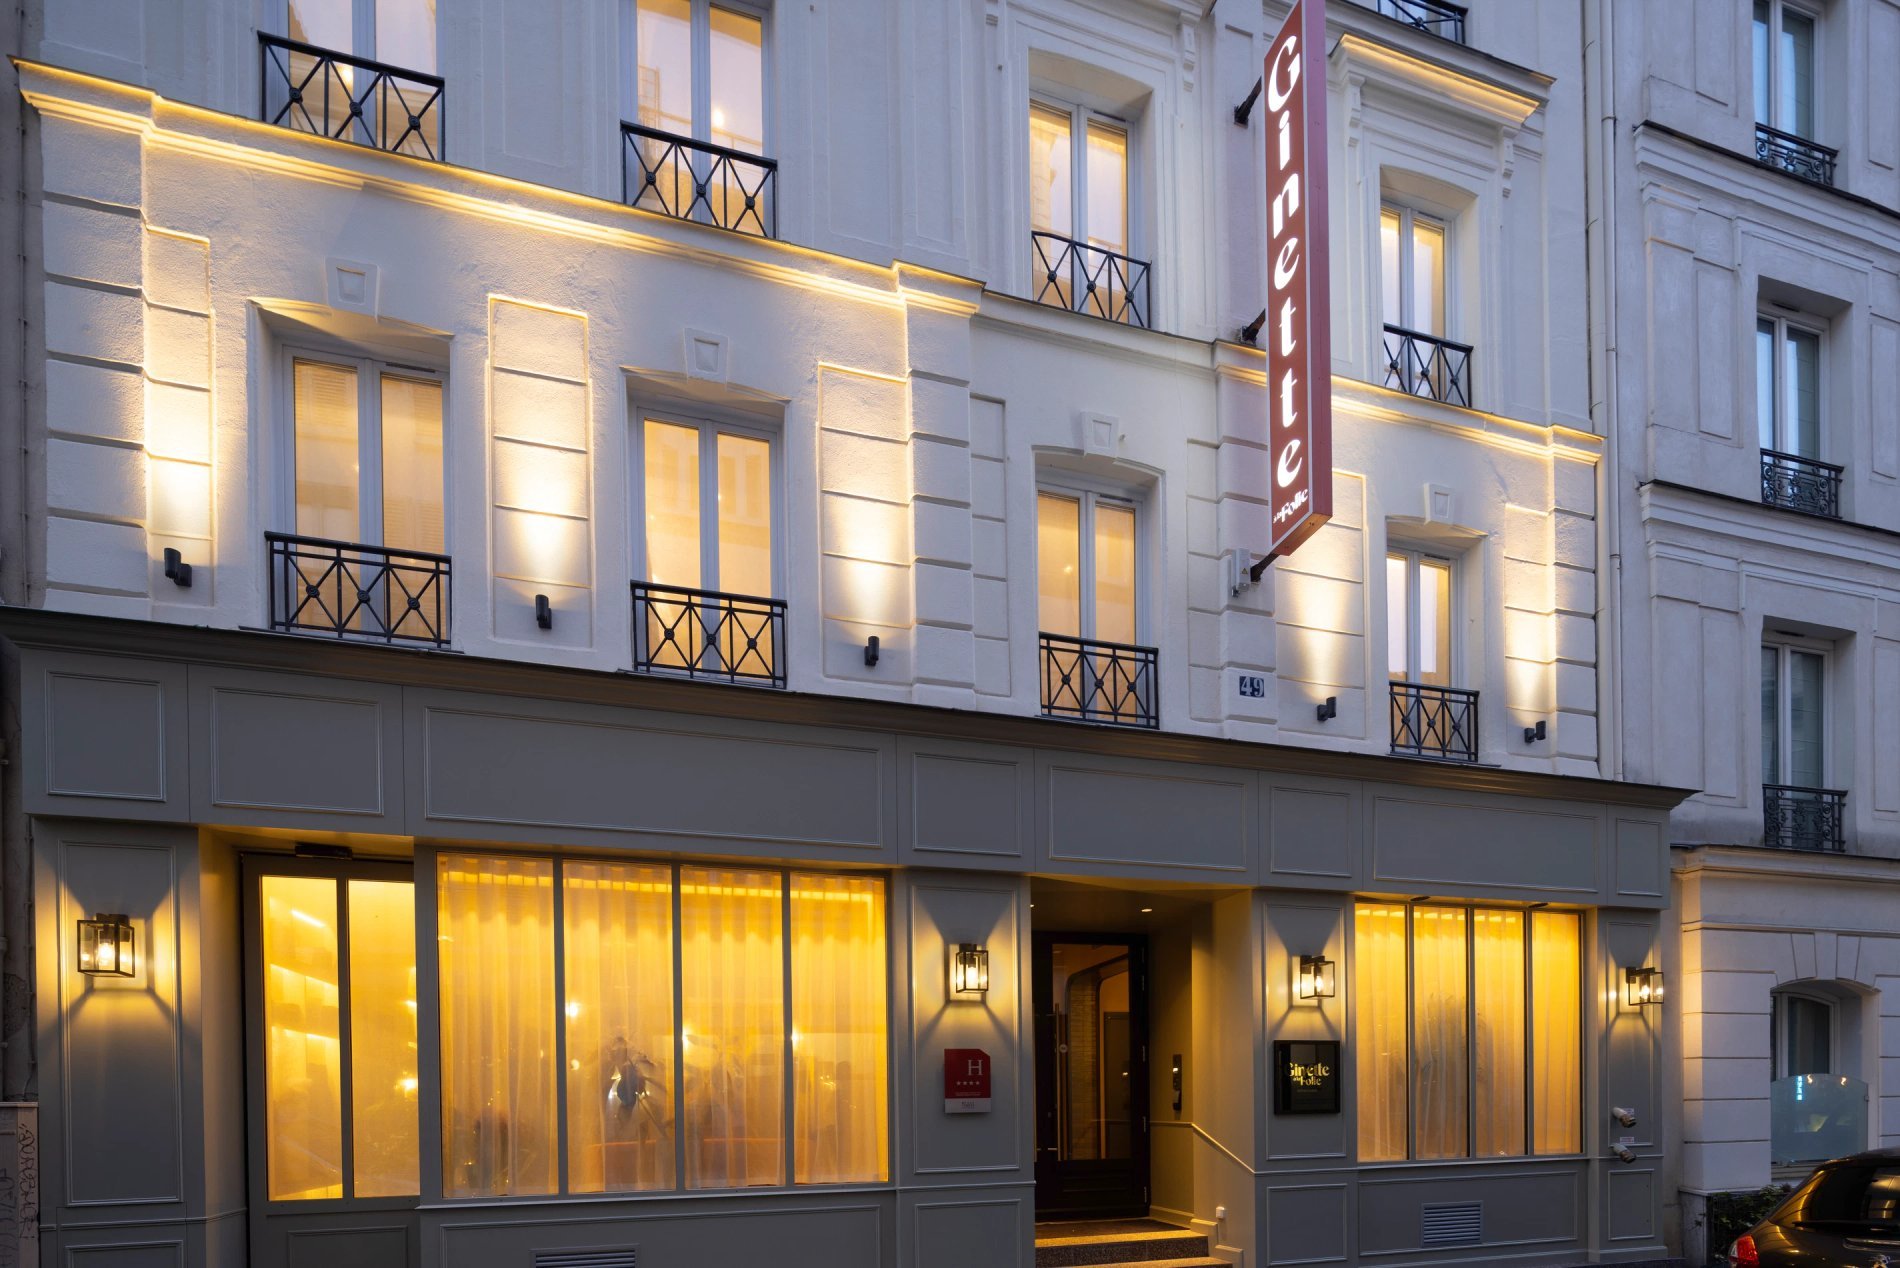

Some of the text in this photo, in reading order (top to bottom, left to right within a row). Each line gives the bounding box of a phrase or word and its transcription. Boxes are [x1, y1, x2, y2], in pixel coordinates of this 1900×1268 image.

[1267, 35, 1303, 488] Ginette
[1240, 676, 1264, 697] 49
[968, 1059, 983, 1076] H
